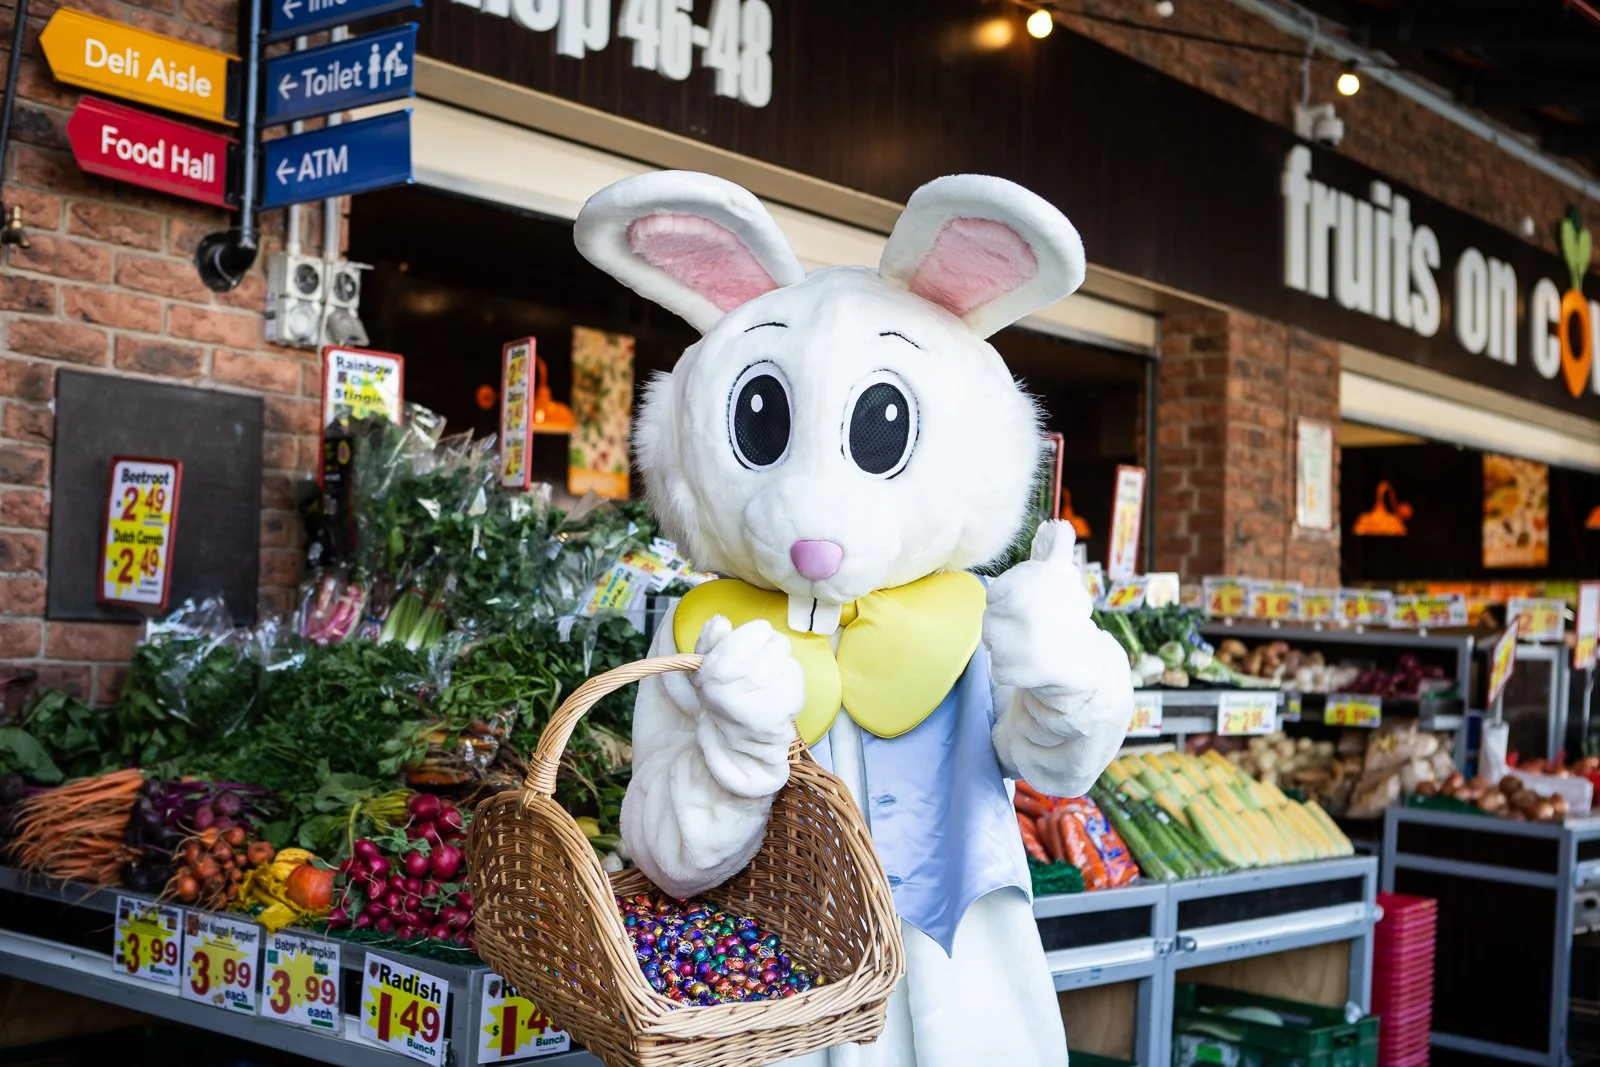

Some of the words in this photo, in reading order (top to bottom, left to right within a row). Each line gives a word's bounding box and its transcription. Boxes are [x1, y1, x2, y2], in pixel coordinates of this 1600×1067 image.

[84, 38, 139, 77] Deli
[147, 57, 212, 98] Aisle
[617, 0, 772, 108] 46-48
[301, 61, 363, 97] Toilet
[101, 125, 165, 170] Food
[171, 144, 215, 182] Hall
[297, 145, 348, 182] ATM
[1282, 145, 1441, 338] fruits
[1456, 247, 1518, 365] on
[336, 355, 394, 375] Rainbow
[122, 468, 169, 485] Beetroot
[275, 937, 296, 955] Baby
[300, 942, 337, 961] Pumpkin
[225, 990, 248, 1004] each
[379, 963, 441, 1005] Radish
[307, 1007, 333, 1021] each
[492, 1005, 562, 1057] $1.4
[406, 1037, 436, 1057] Bunch
[536, 1034, 566, 1047] Bunch
